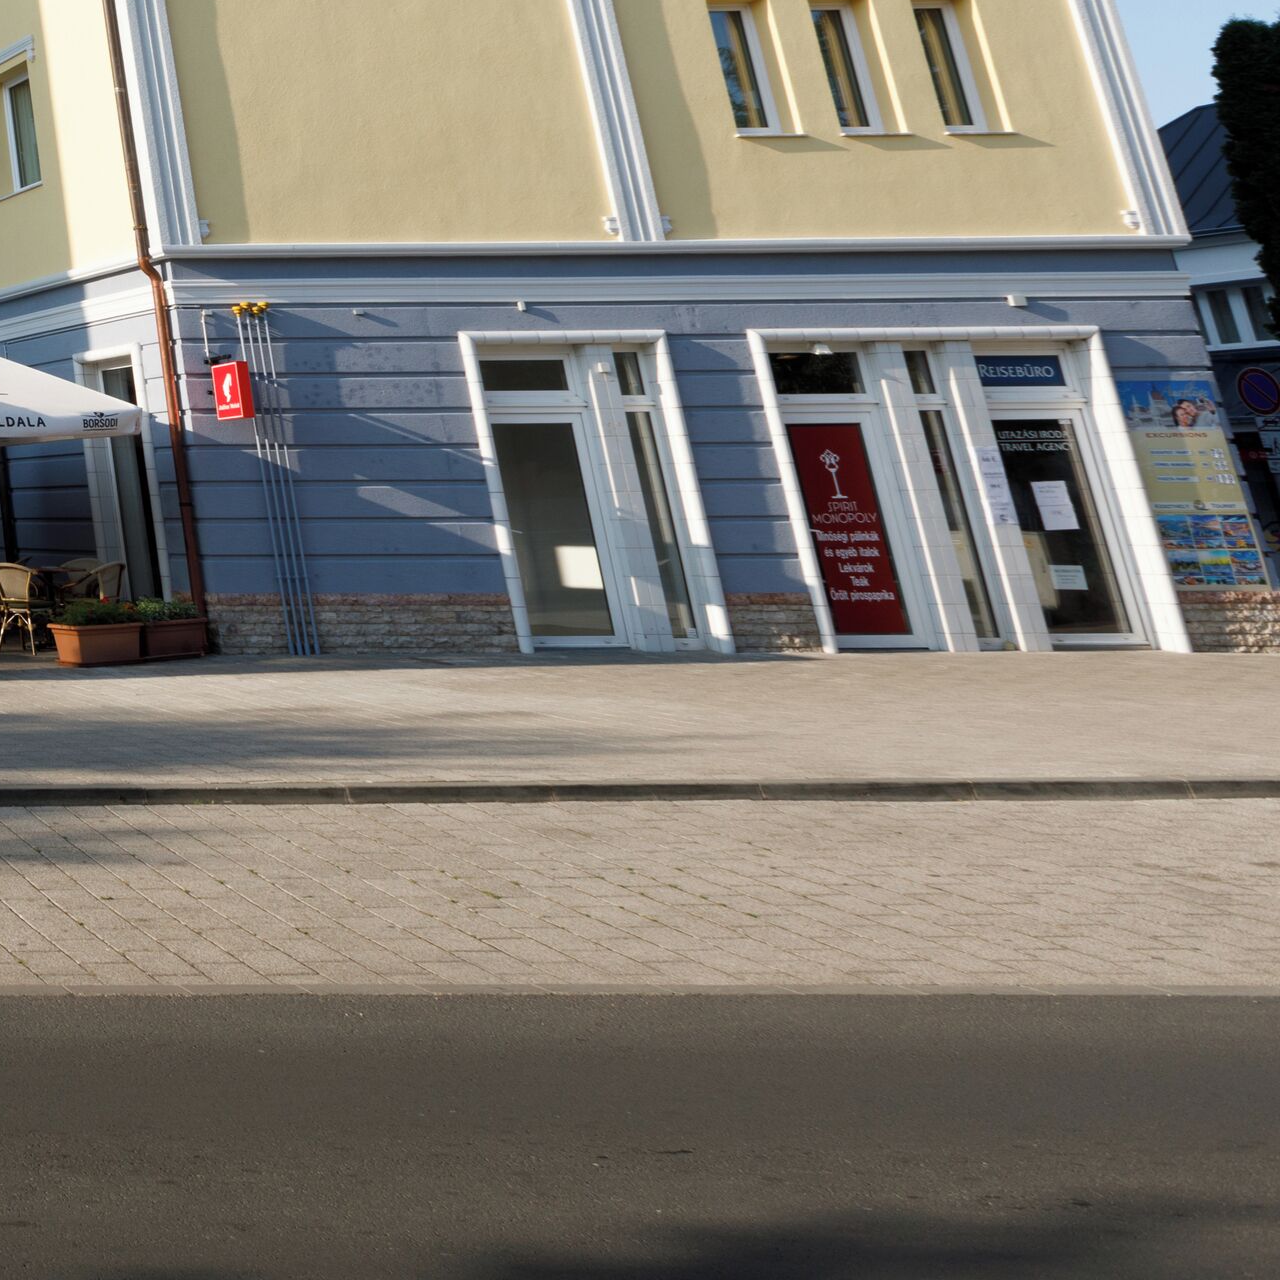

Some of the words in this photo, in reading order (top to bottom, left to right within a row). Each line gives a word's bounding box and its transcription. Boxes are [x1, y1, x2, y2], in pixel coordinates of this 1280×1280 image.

[83, 418, 119, 429] BORSODI
[997, 429, 1038, 439] UTAZÁSI
[1040, 431, 1069, 439] IRODA
[1000, 443, 1035, 452] TRAVEL
[827, 501, 857, 513] SPIRIT
[812, 512, 877, 524] MONOPOLY
[824, 547, 834, 557] és
[835, 547, 858, 559] egyéb
[858, 547, 880, 557] italok
[838, 562, 875, 573] Lekvárok
[849, 575, 870, 586] Teák
[850, 589, 895, 602] pirospaprika
